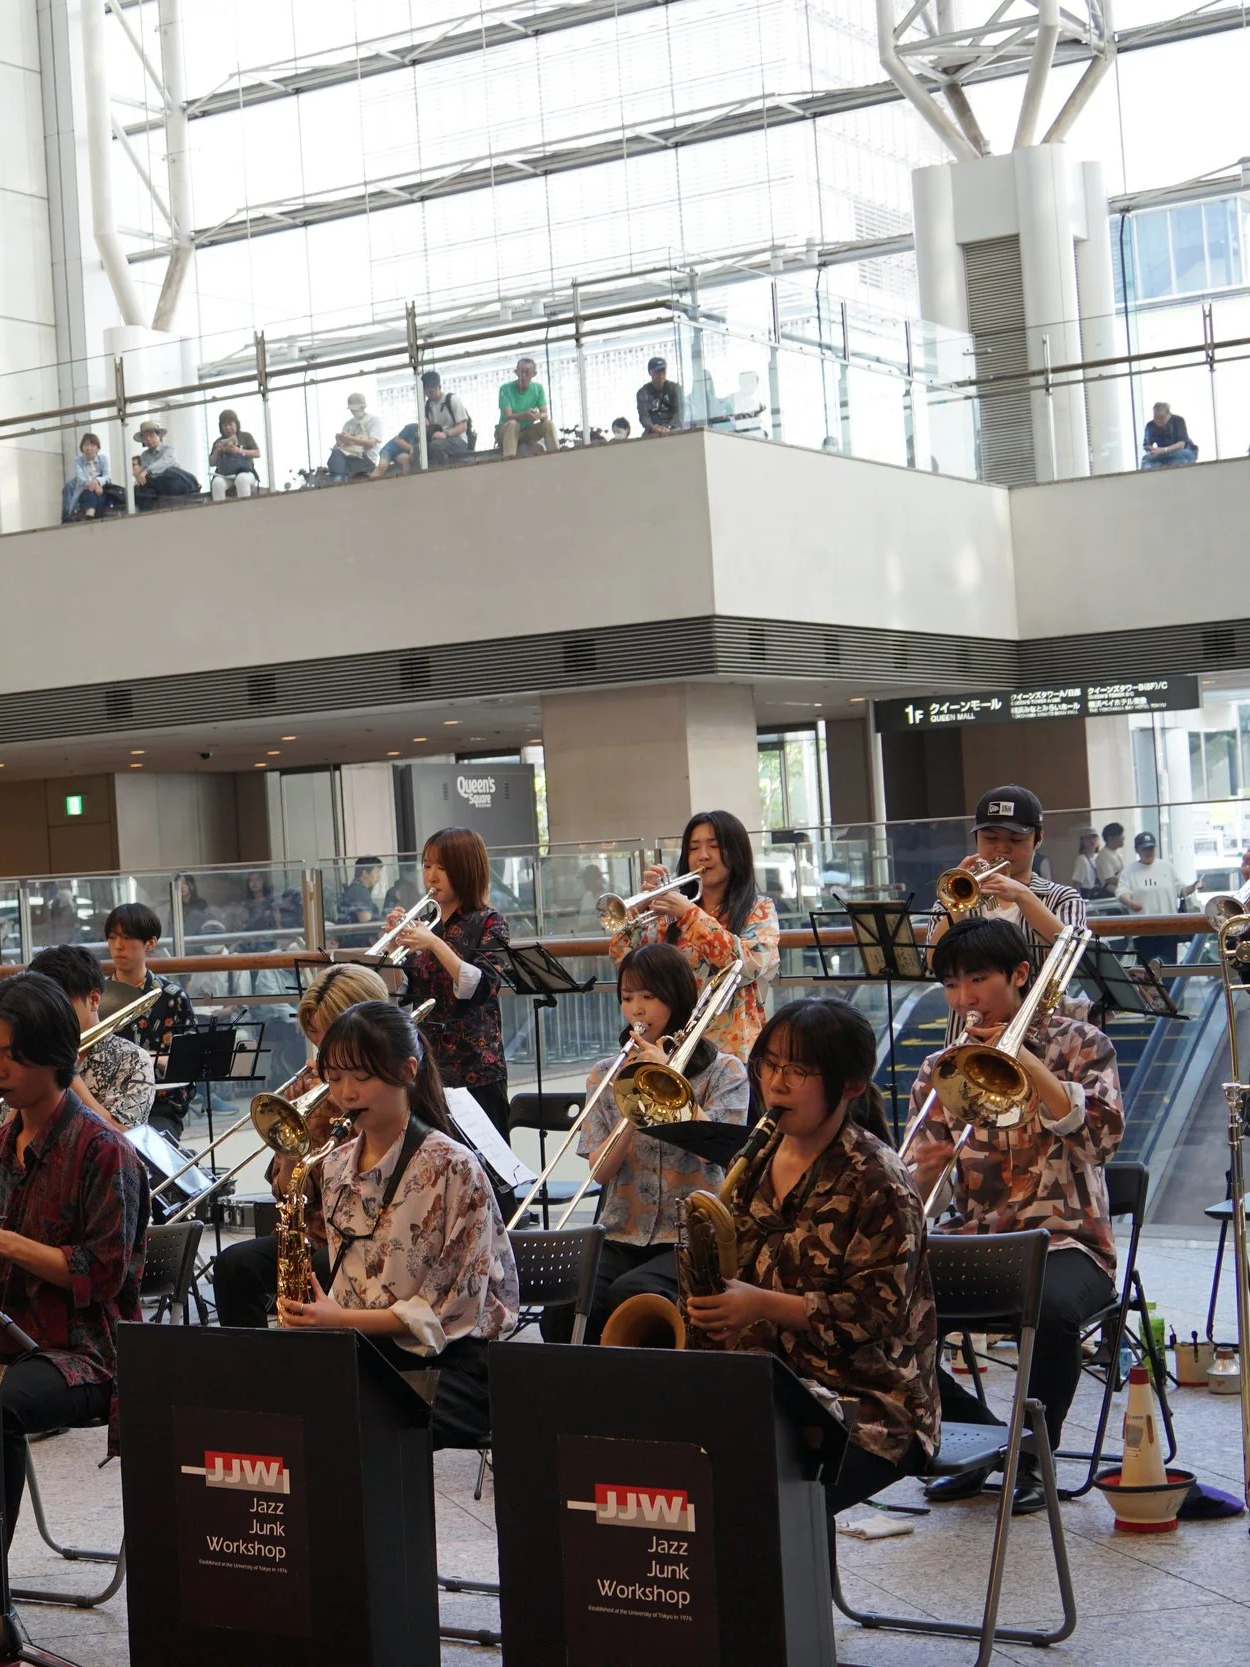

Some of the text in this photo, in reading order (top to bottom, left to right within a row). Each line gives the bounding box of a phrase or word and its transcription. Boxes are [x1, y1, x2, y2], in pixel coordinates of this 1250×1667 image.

[905, 704, 924, 725] 1F
[930, 698, 1002, 715] クイーンモール
[930, 712, 976, 723] QUEEN MALL
[457, 776, 496, 798] Queen's
[468, 793, 492, 808] Square
[249, 1497, 284, 1515] Jazz
[249, 1519, 286, 1537] Junk
[206, 1535, 286, 1562] Workshop
[648, 1536, 688, 1556] Jazz
[647, 1560, 690, 1580] Junk
[597, 1578, 691, 1609] Workshop
[628, 1610, 652, 1618] University
